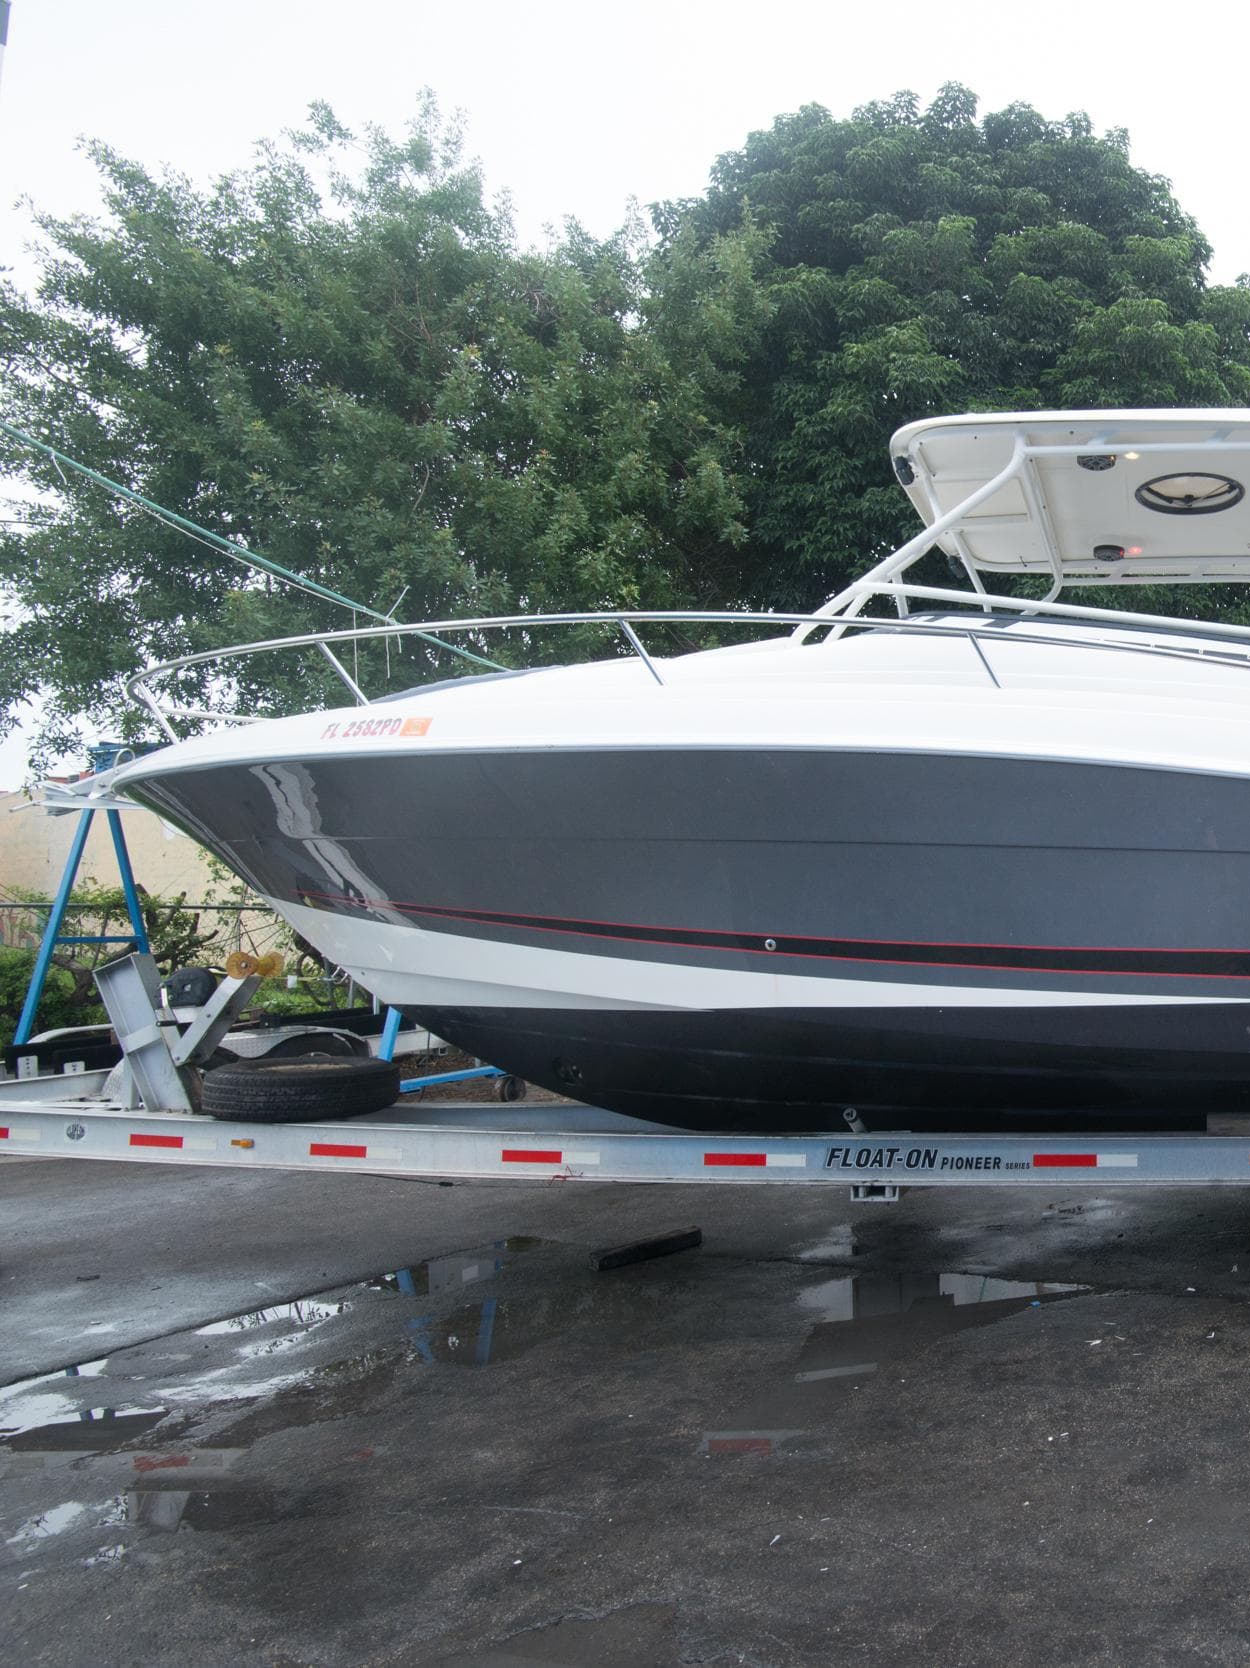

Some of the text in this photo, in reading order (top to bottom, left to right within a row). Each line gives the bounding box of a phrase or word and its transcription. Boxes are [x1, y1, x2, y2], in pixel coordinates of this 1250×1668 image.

[320, 723, 341, 739] FL
[826, 1148, 1030, 1170] FLOAT-ON PIONEER SERIES
